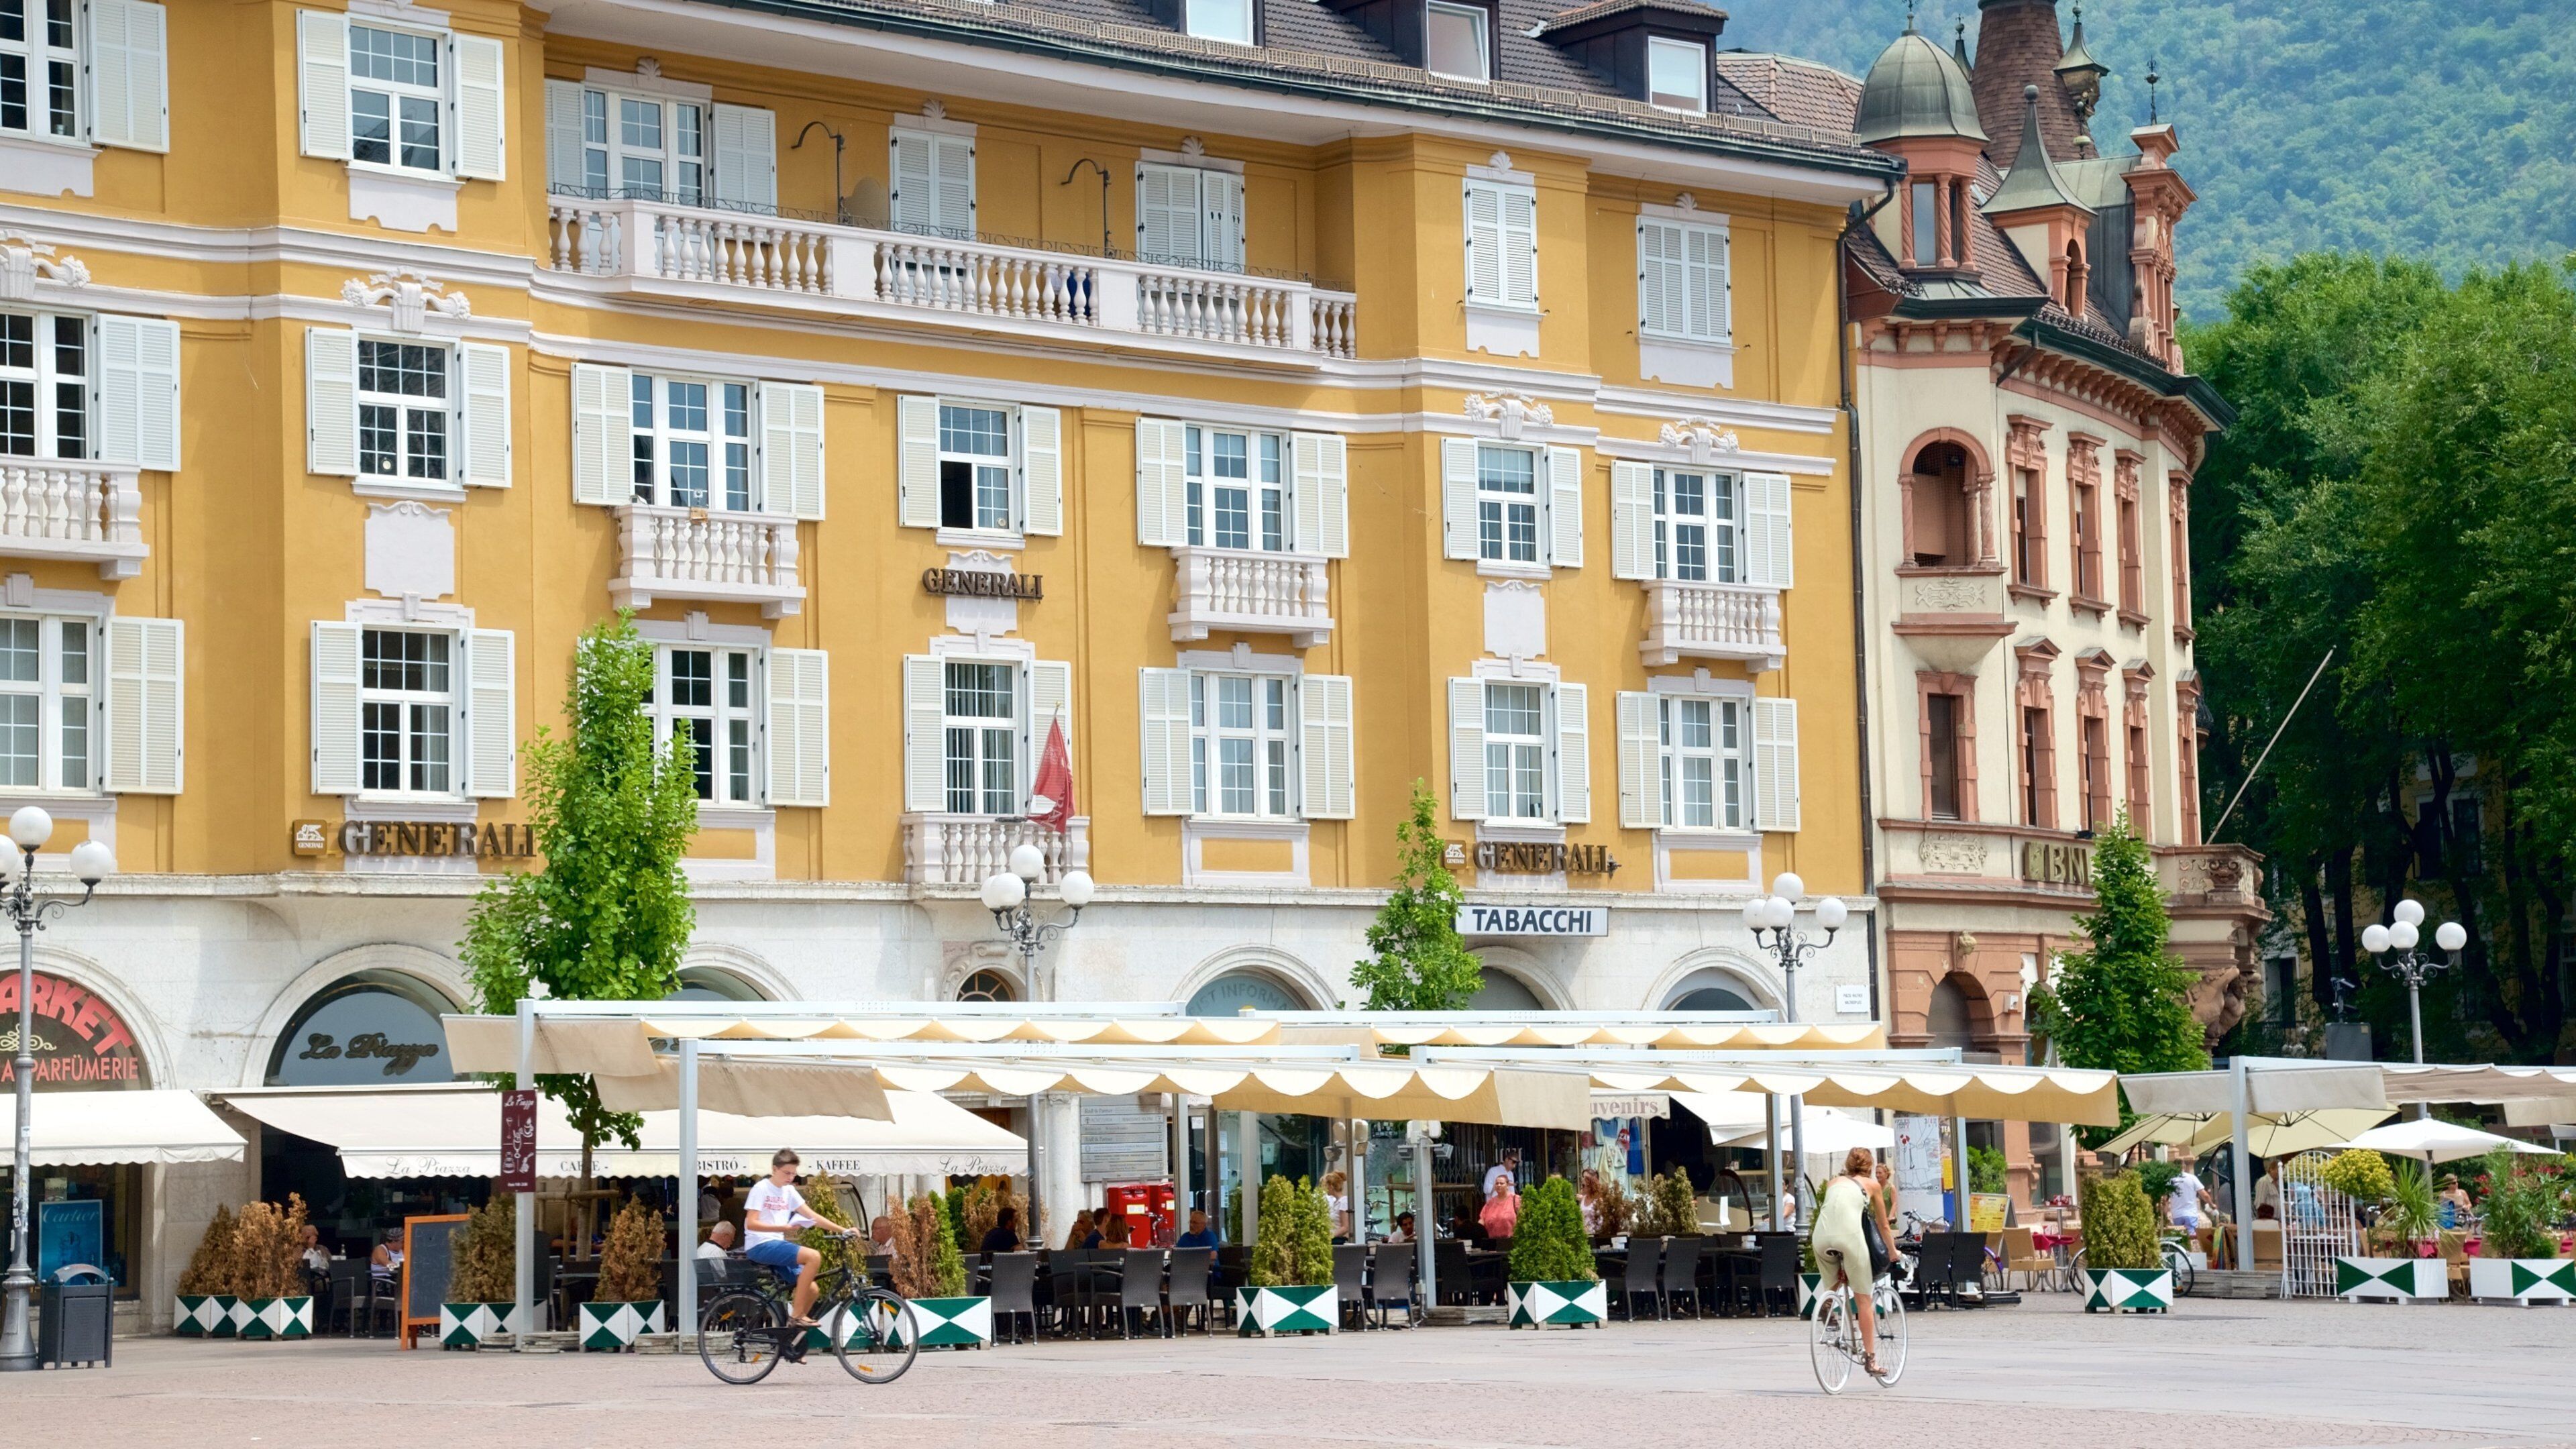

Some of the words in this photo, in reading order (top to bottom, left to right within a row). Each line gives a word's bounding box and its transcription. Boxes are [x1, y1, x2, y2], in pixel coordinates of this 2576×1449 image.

[922, 568, 1044, 599] GENERALI
[338, 820, 537, 858] GENERALI
[1472, 841, 1608, 873] GENERALI
[1472, 909, 1592, 932] TABACCHI
[299, 1033, 342, 1059] La
[345, 1032, 439, 1075] Piazza
[386, 1156, 411, 1175] La
[418, 1156, 472, 1173] Piazza
[560, 1161, 600, 1171] CAFE
[816, 1160, 860, 1171] KAFFEE
[938, 1155, 958, 1173] La
[963, 1155, 1008, 1173] Piazza
[42, 1207, 99, 1223] Cartier
